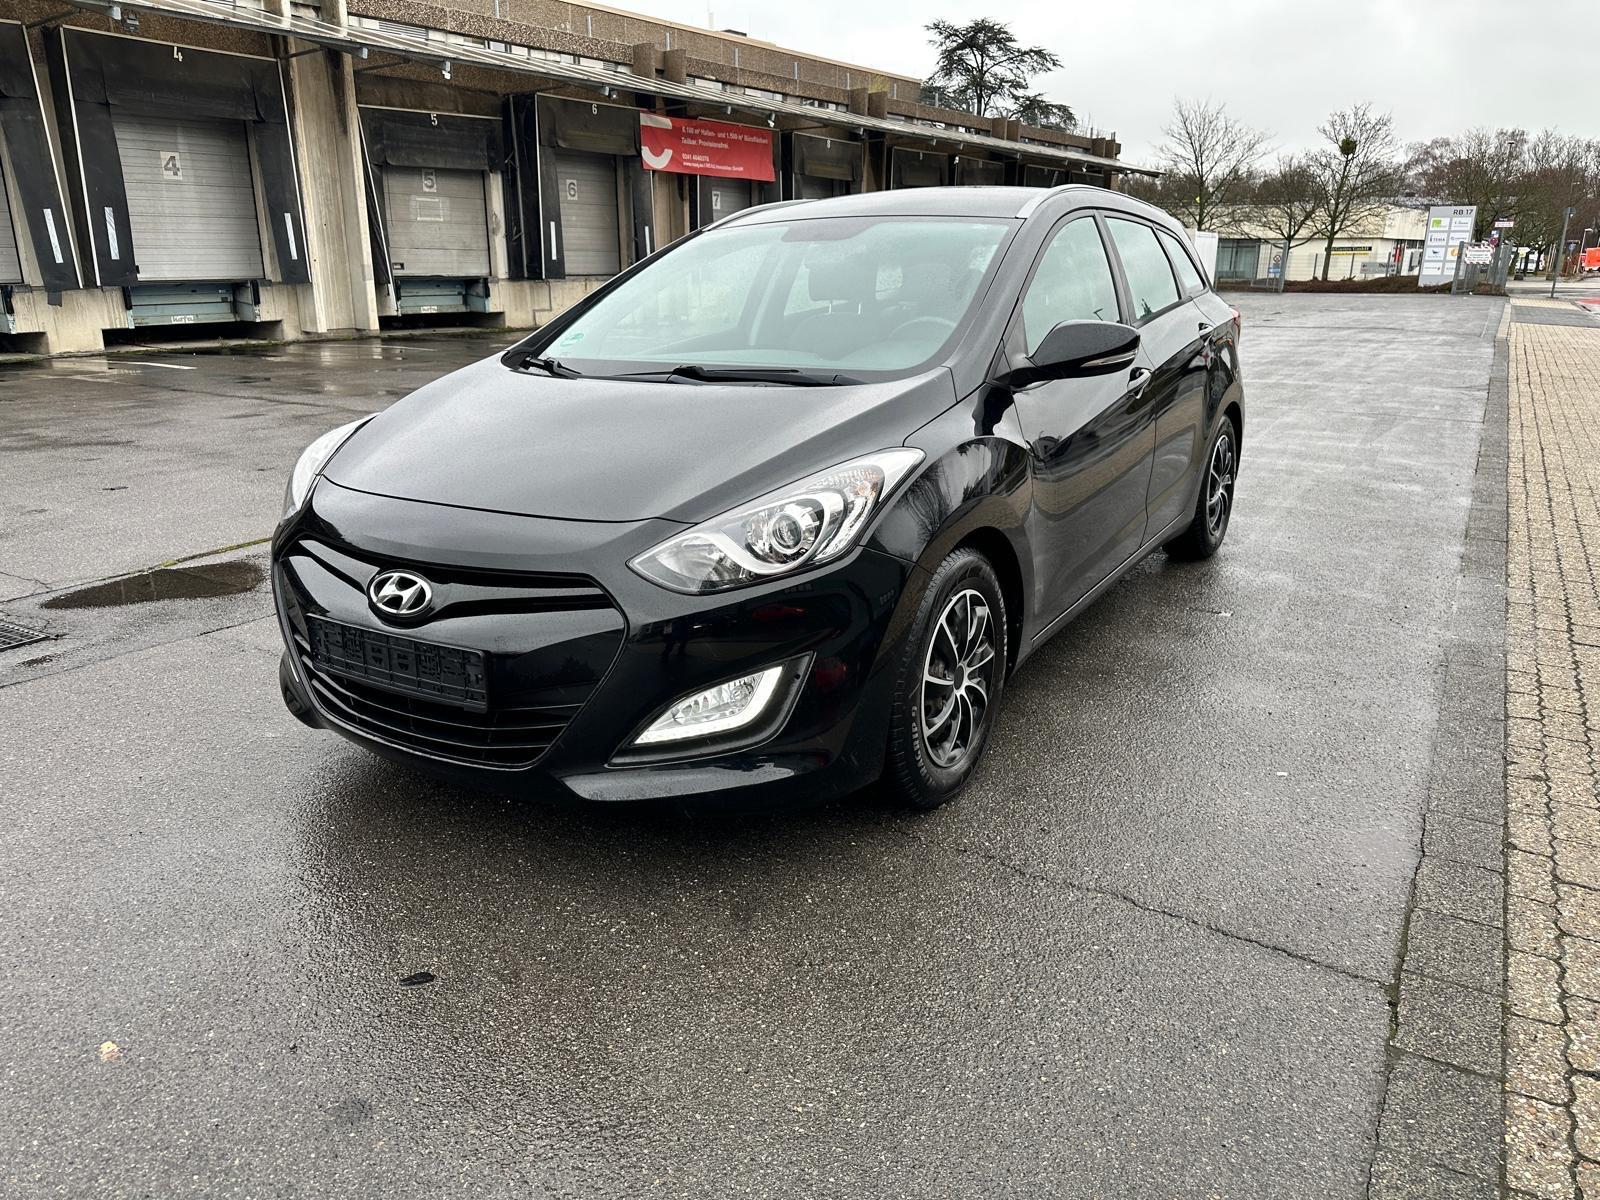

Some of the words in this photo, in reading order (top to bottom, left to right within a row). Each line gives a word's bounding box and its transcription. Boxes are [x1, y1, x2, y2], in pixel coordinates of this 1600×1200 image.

[174, 46, 183, 62] 4
[592, 104, 597, 115] 6
[431, 113, 438, 126] 5
[163, 155, 180, 177] 4
[424, 171, 435, 189] 5
[567, 181, 577, 198] 6
[713, 193, 719, 207] 7
